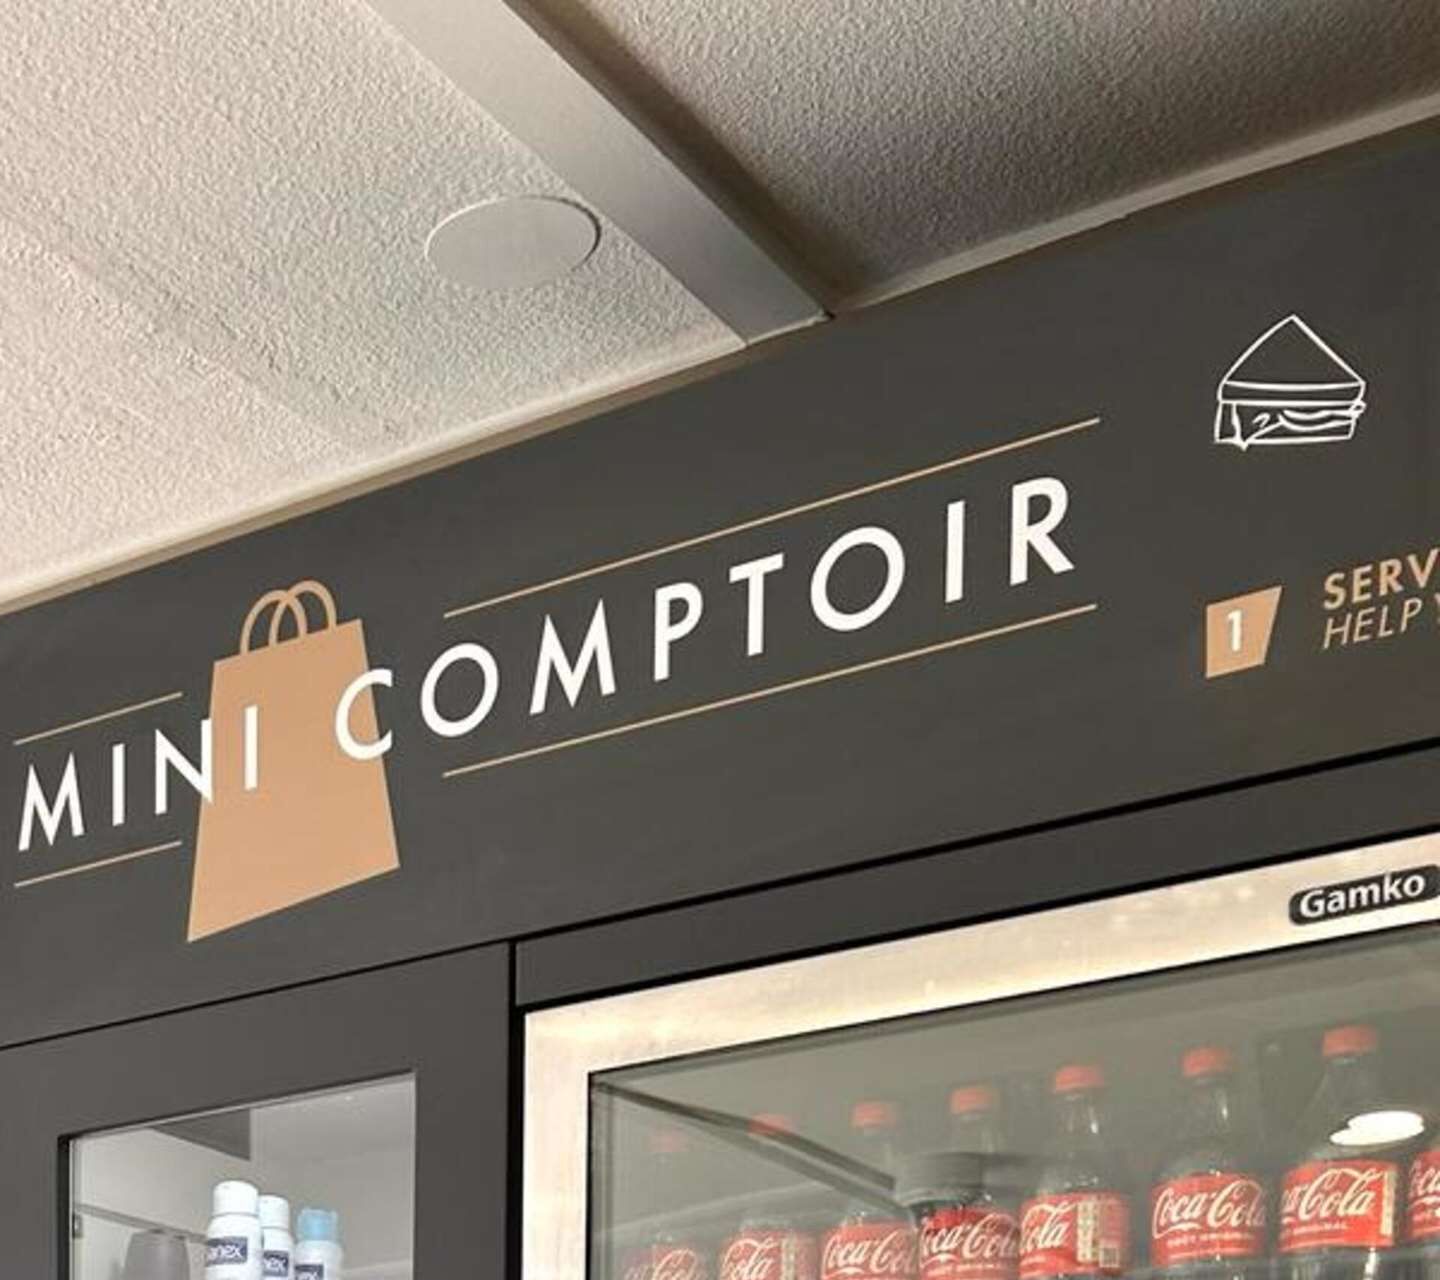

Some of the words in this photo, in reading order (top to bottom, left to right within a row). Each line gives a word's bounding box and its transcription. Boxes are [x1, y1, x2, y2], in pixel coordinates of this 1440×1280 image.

[1323, 547, 1440, 609] SERV
[1226, 610, 1242, 652] 1
[1322, 597, 1423, 650] HELP
[17, 705, 258, 852] MINI
[334, 476, 1075, 761] COMPTOIR
[1299, 871, 1426, 920] Gamko
